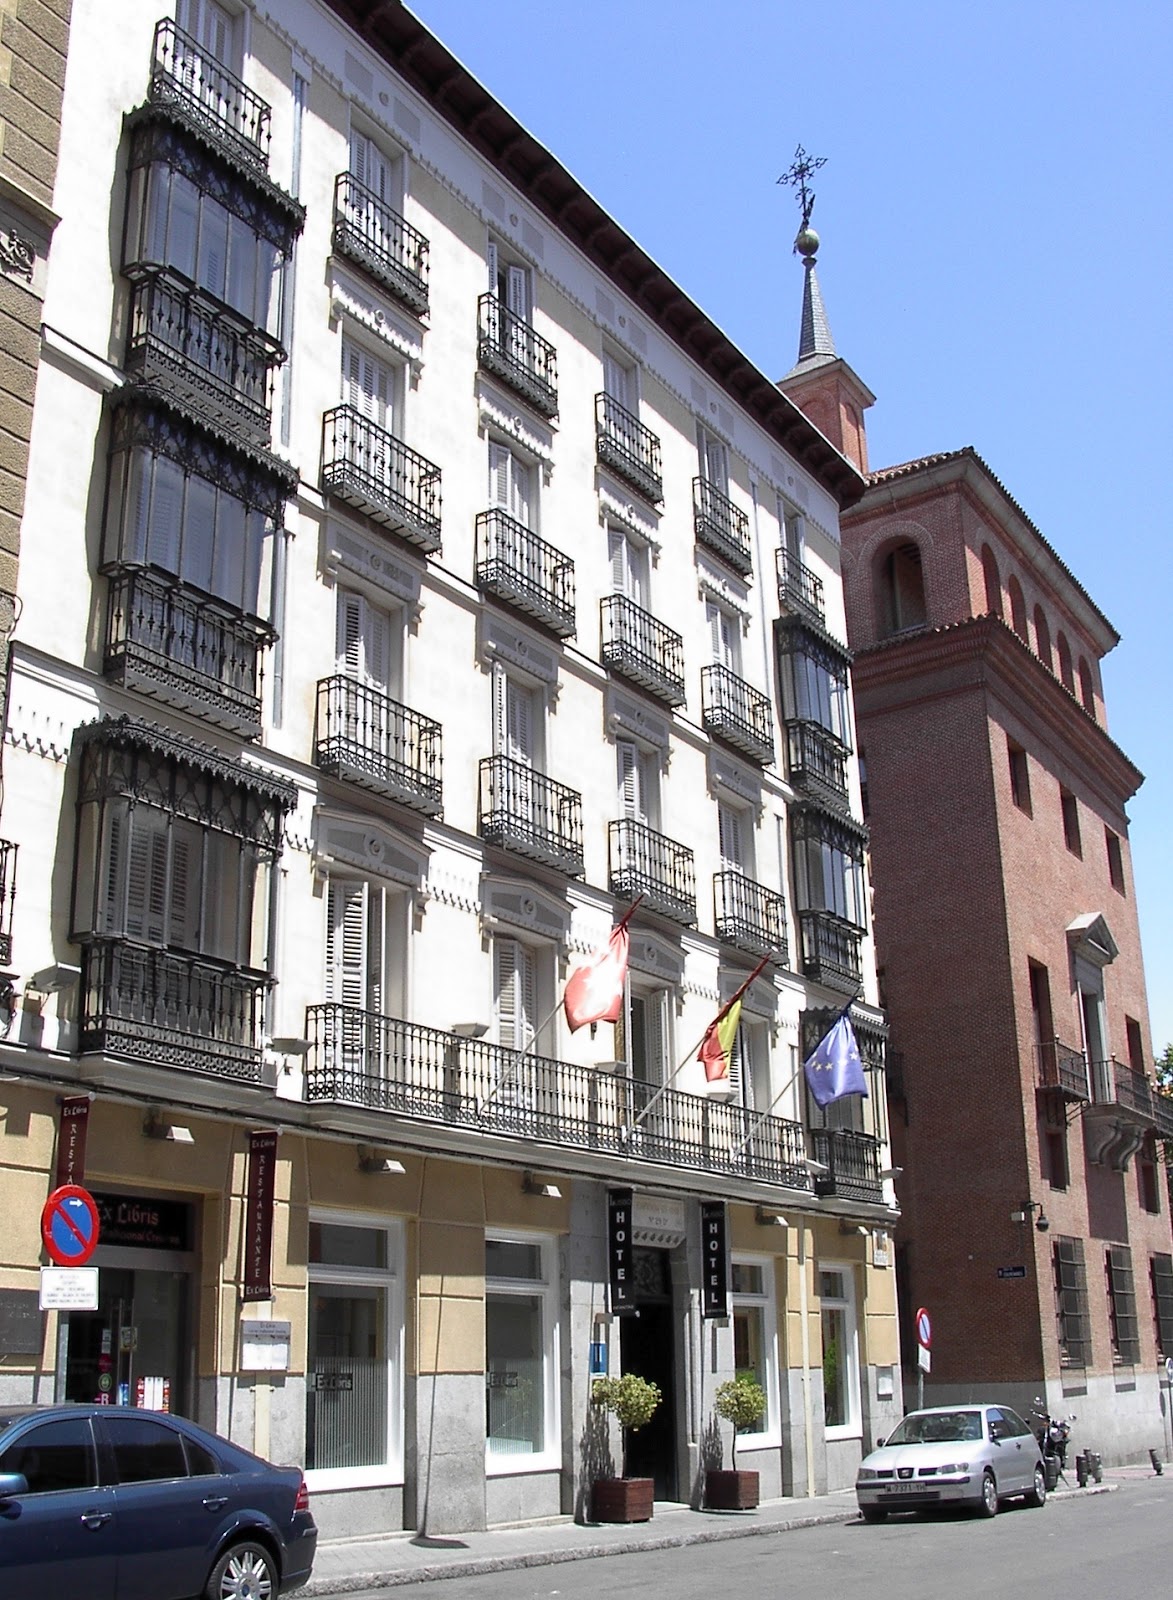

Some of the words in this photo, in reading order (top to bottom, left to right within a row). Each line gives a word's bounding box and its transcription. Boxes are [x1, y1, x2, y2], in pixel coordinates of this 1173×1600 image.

[66, 1123, 77, 1185] RESTA
[117, 1202, 159, 1226] Libris
[255, 1155, 265, 1278] RESTAURANTE
[616, 1211, 625, 1299] HOTEL
[709, 1223, 718, 1303] HOTEL
